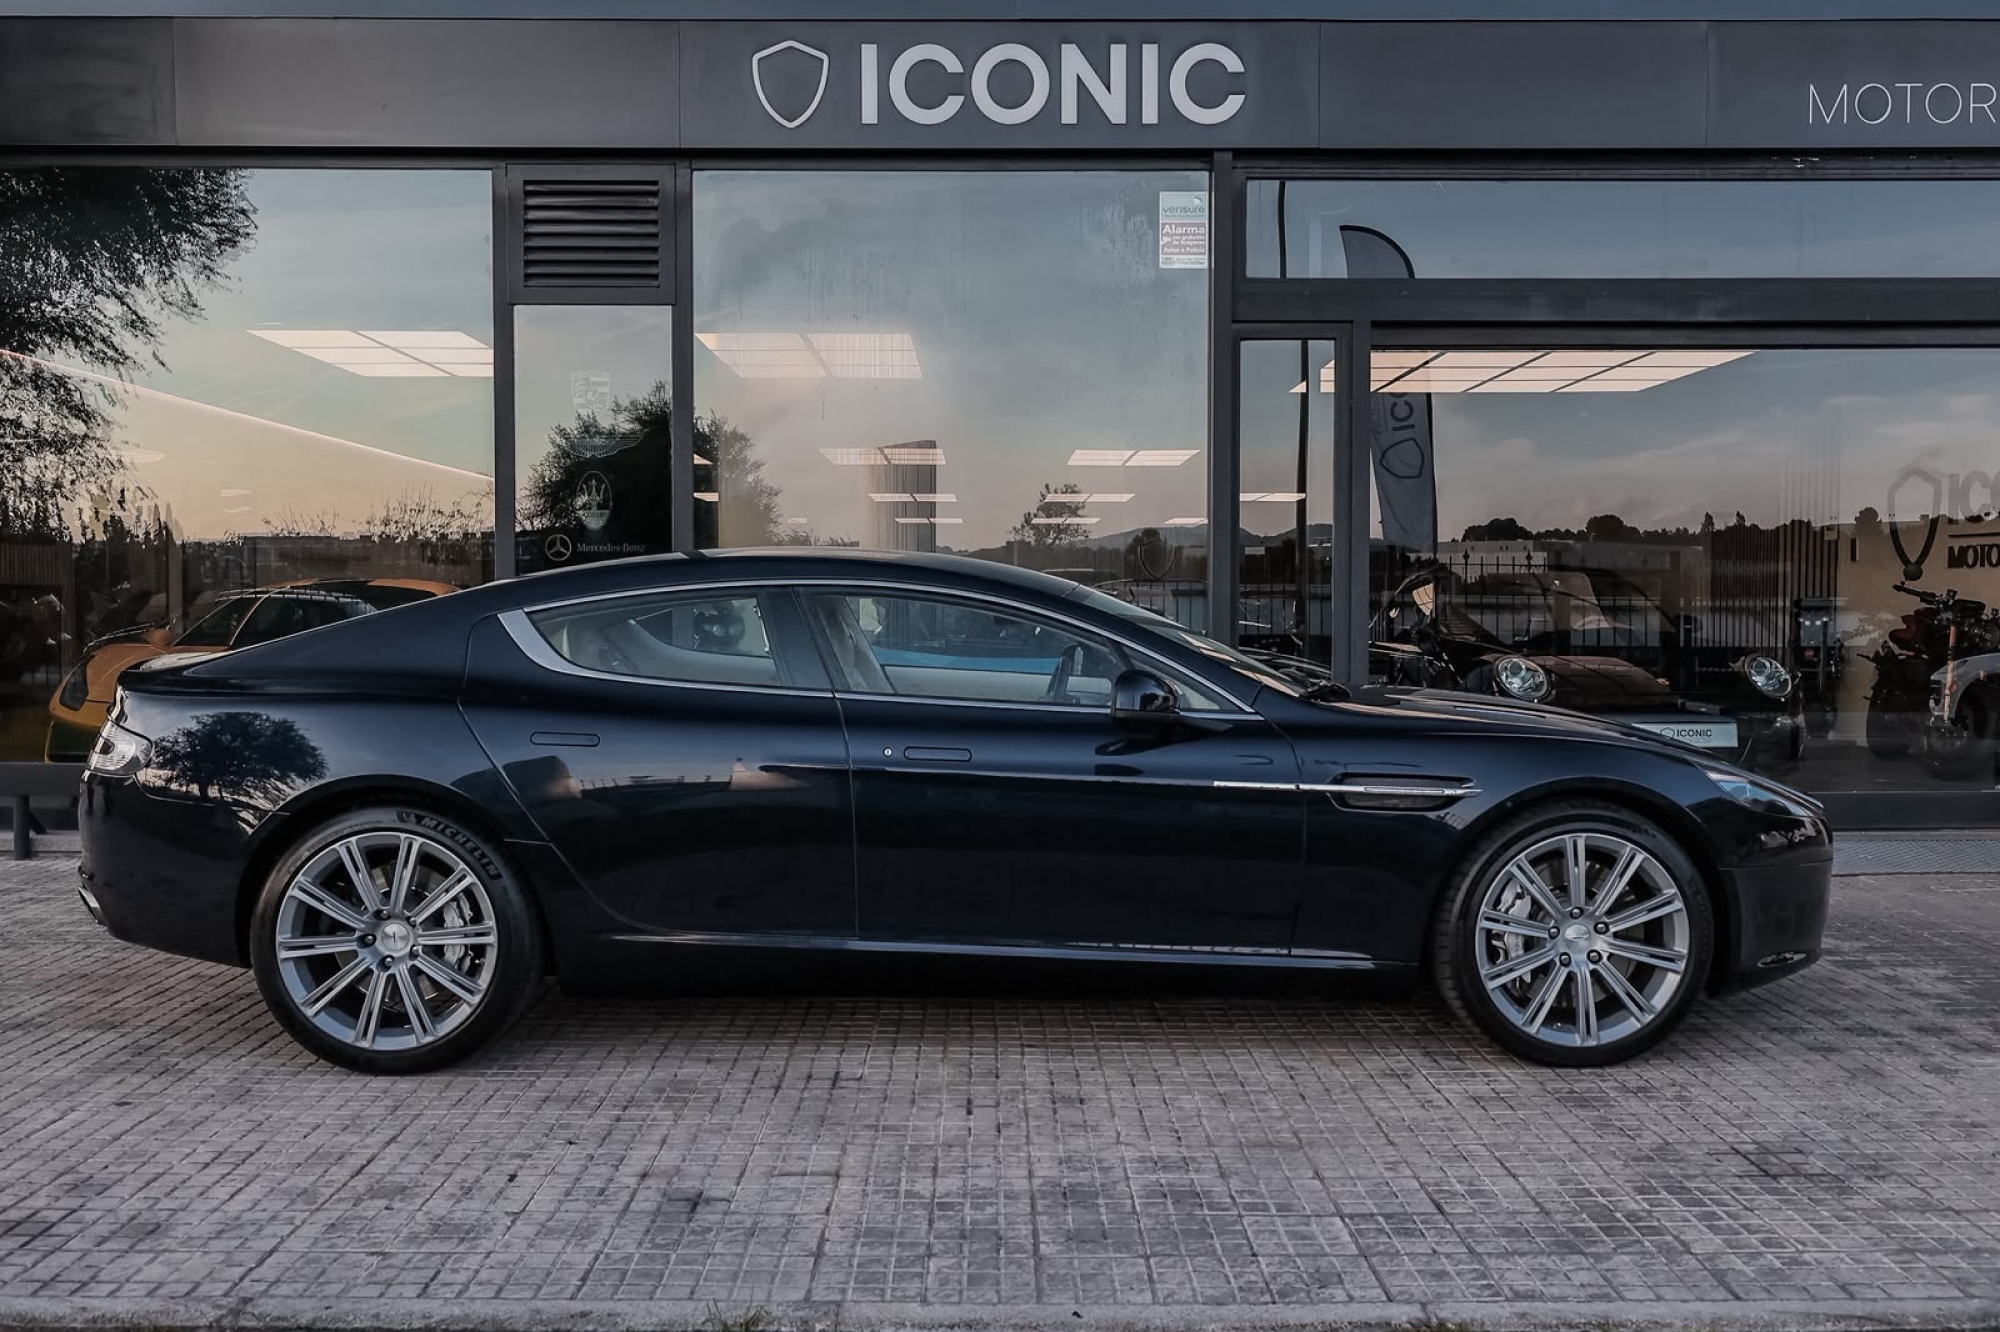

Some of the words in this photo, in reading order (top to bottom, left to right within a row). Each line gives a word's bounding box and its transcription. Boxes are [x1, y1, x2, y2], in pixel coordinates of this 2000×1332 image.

[860, 43, 1246, 126] ICONIC
[1808, 83, 1997, 124] MOTOR
[1163, 205, 1205, 214] verisure
[1163, 224, 1205, 234] Alarma
[576, 542, 646, 552] Mercedes-Benz
[1947, 543, 2000, 569] MOTO
[1676, 729, 1713, 738] ICONIC
[420, 816, 500, 877] MICHELIN
